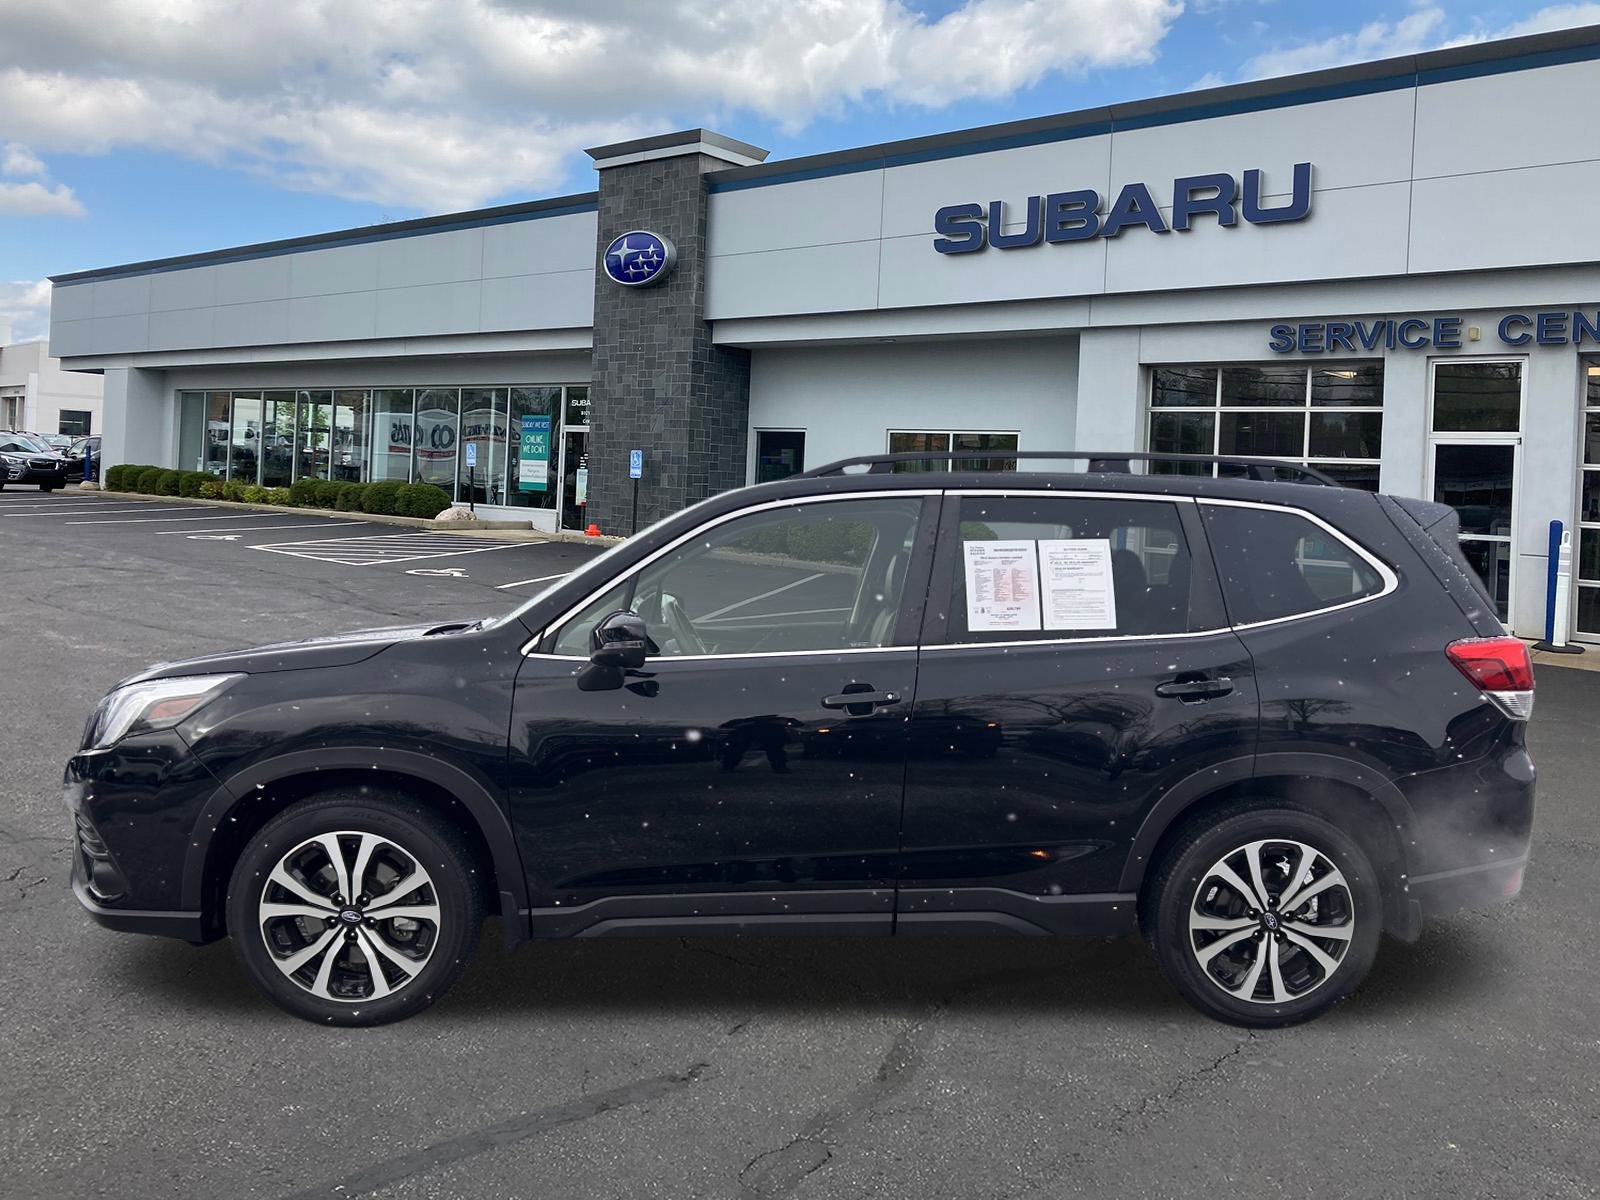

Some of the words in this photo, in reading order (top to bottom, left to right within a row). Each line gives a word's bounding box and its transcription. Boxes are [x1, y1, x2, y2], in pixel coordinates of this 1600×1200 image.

[933, 162, 1313, 254] SUBARU
[1269, 317, 1463, 353] SERVICE
[1498, 311, 1600, 346] CEN
[522, 445, 530, 454] WE
[525, 434, 544, 444] ONLINE
